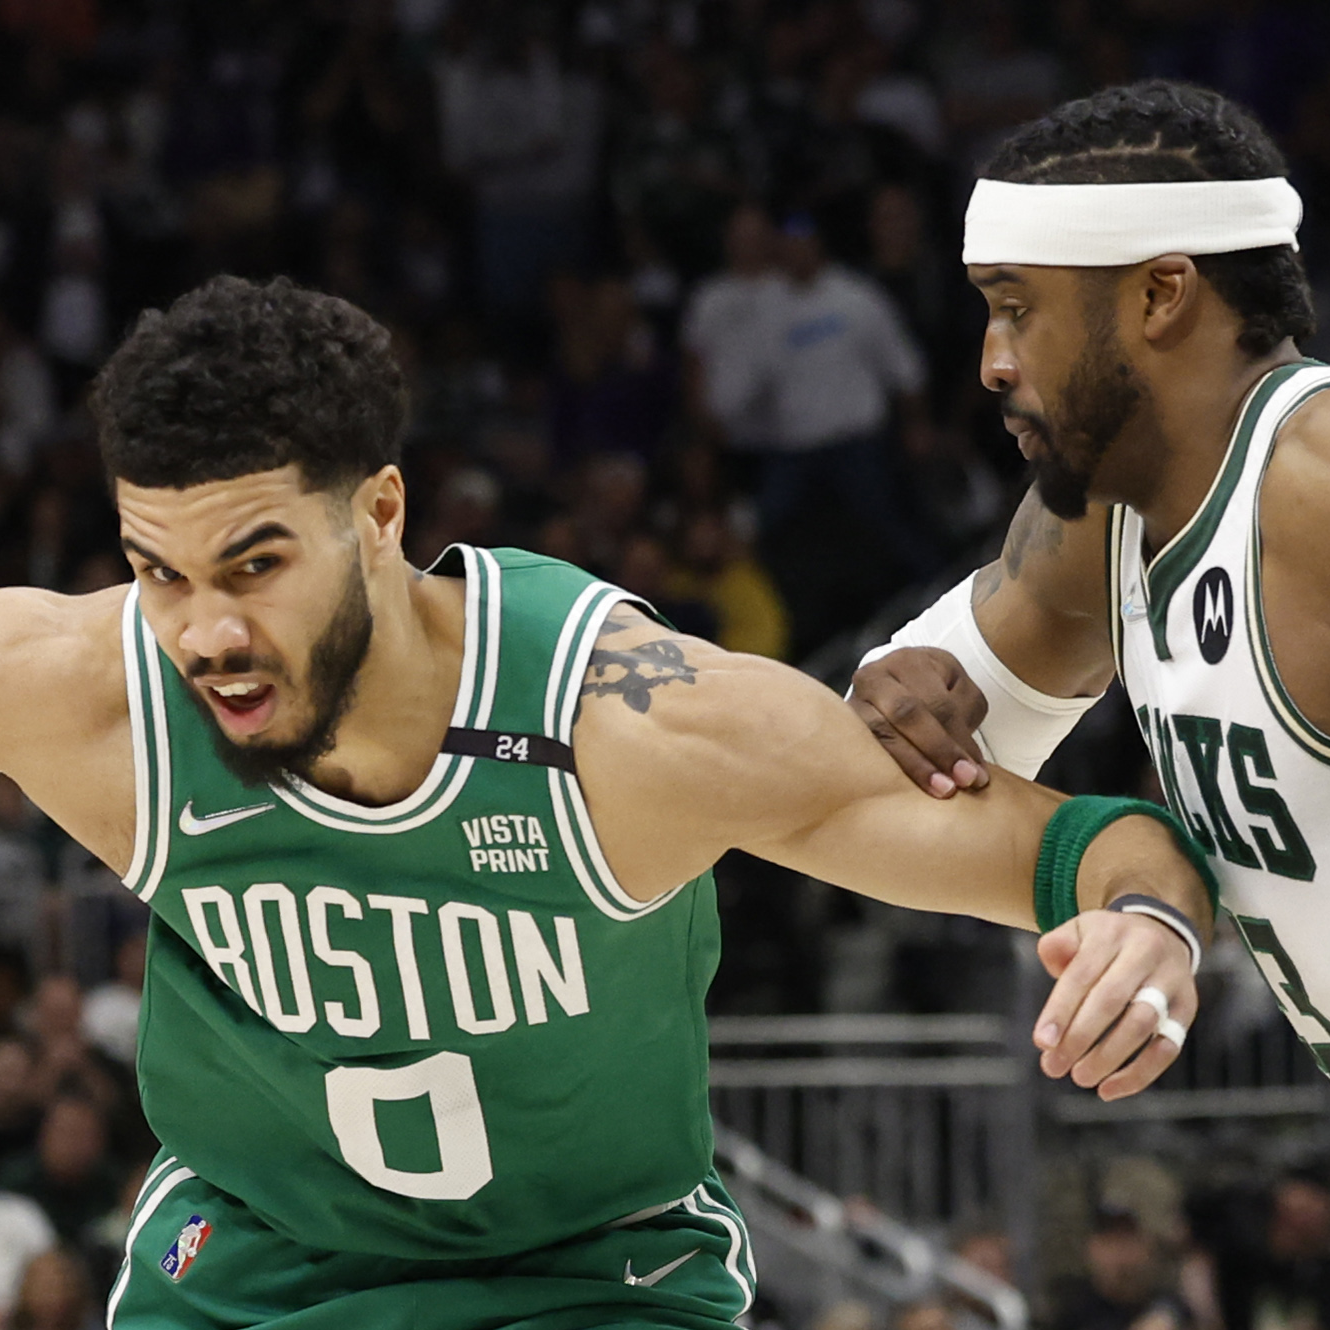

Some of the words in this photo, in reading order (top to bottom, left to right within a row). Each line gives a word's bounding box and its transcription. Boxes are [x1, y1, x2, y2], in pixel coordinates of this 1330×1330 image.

[495, 734, 530, 762] 24
[461, 814, 548, 850] VISTA
[470, 847, 550, 874] PRINT
[181, 882, 590, 1041] BOSTON
[324, 1050, 494, 1201] 0
